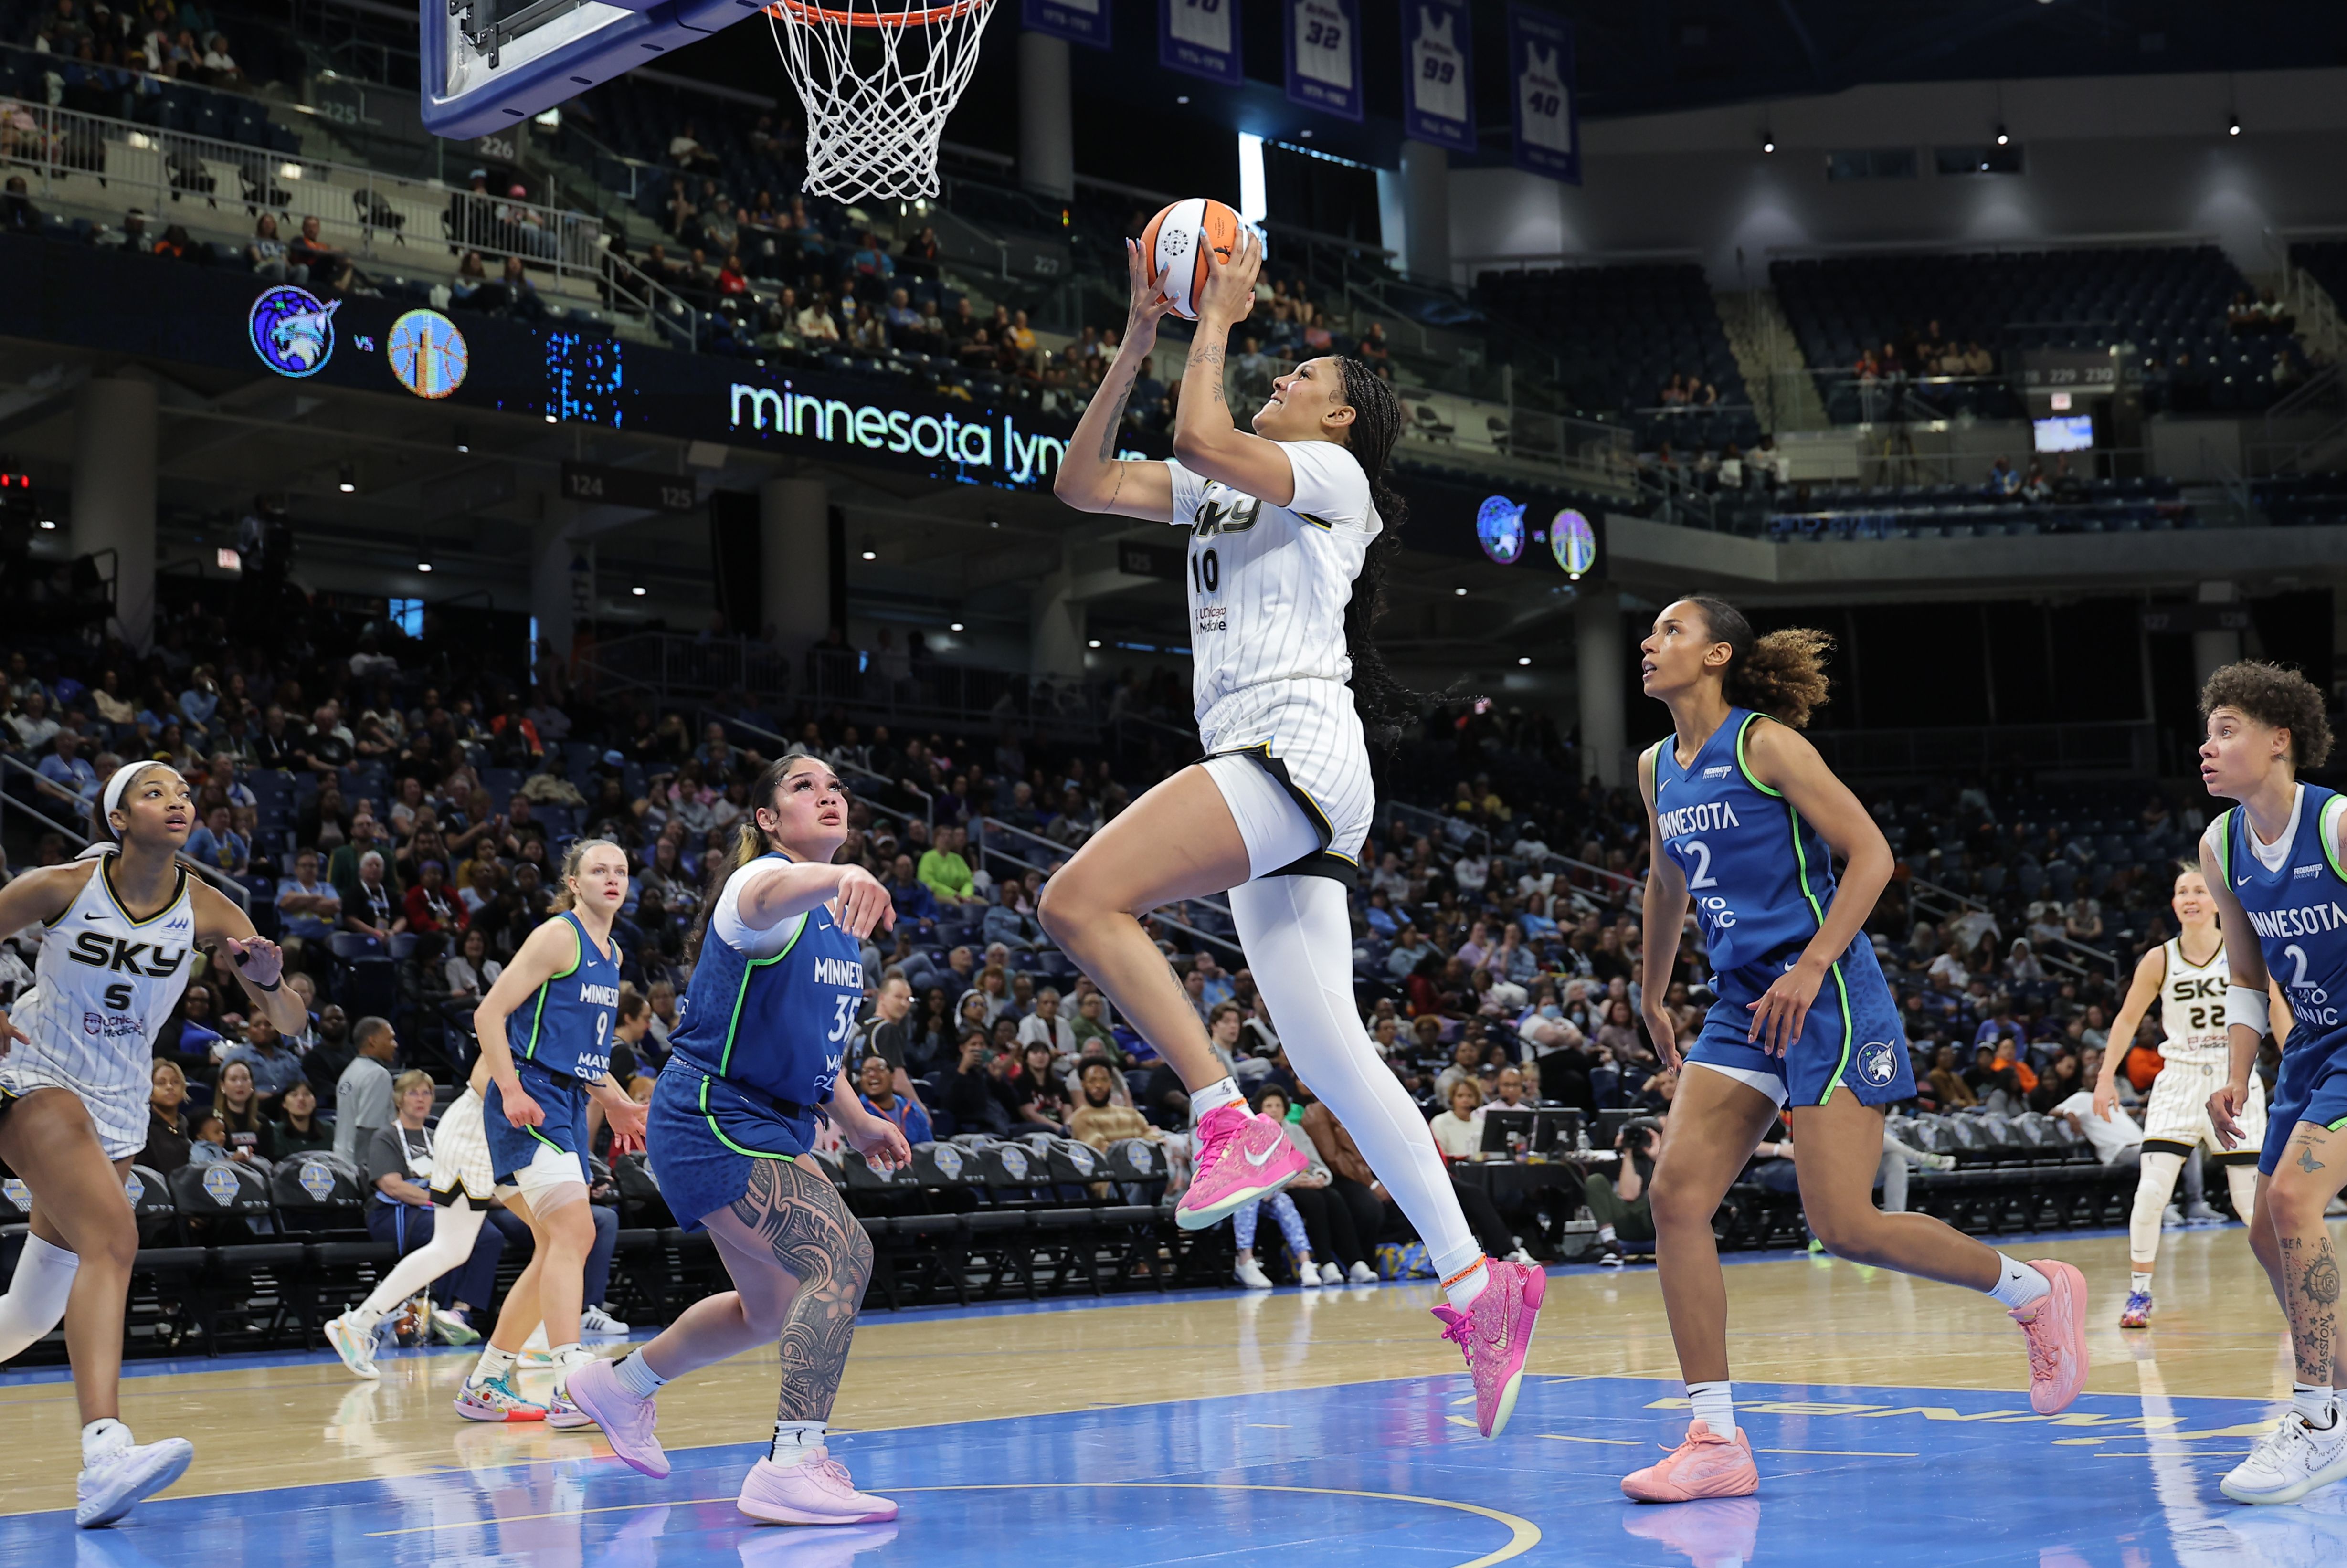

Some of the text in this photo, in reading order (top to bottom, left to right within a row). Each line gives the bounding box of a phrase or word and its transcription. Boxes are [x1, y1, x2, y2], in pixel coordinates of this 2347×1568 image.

[1306, 21, 1341, 50] 32
[1423, 57, 1455, 84] 99
[1529, 90, 1560, 117] 40
[480, 136, 514, 160] 226
[730, 380, 1069, 484] minnesota lyn
[570, 474, 692, 509] 124 125
[1192, 547, 1220, 595] 10
[2294, 863, 2323, 875] FEDERATED
[67, 930, 186, 978] SKY
[2284, 943, 2318, 989] 2
[104, 982, 133, 1011] 5
[596, 1010, 609, 1047] 9
[827, 993, 862, 1043] 35
[2189, 1005, 2225, 1029] 22
[2318, 1317, 2329, 1373] PASSION
